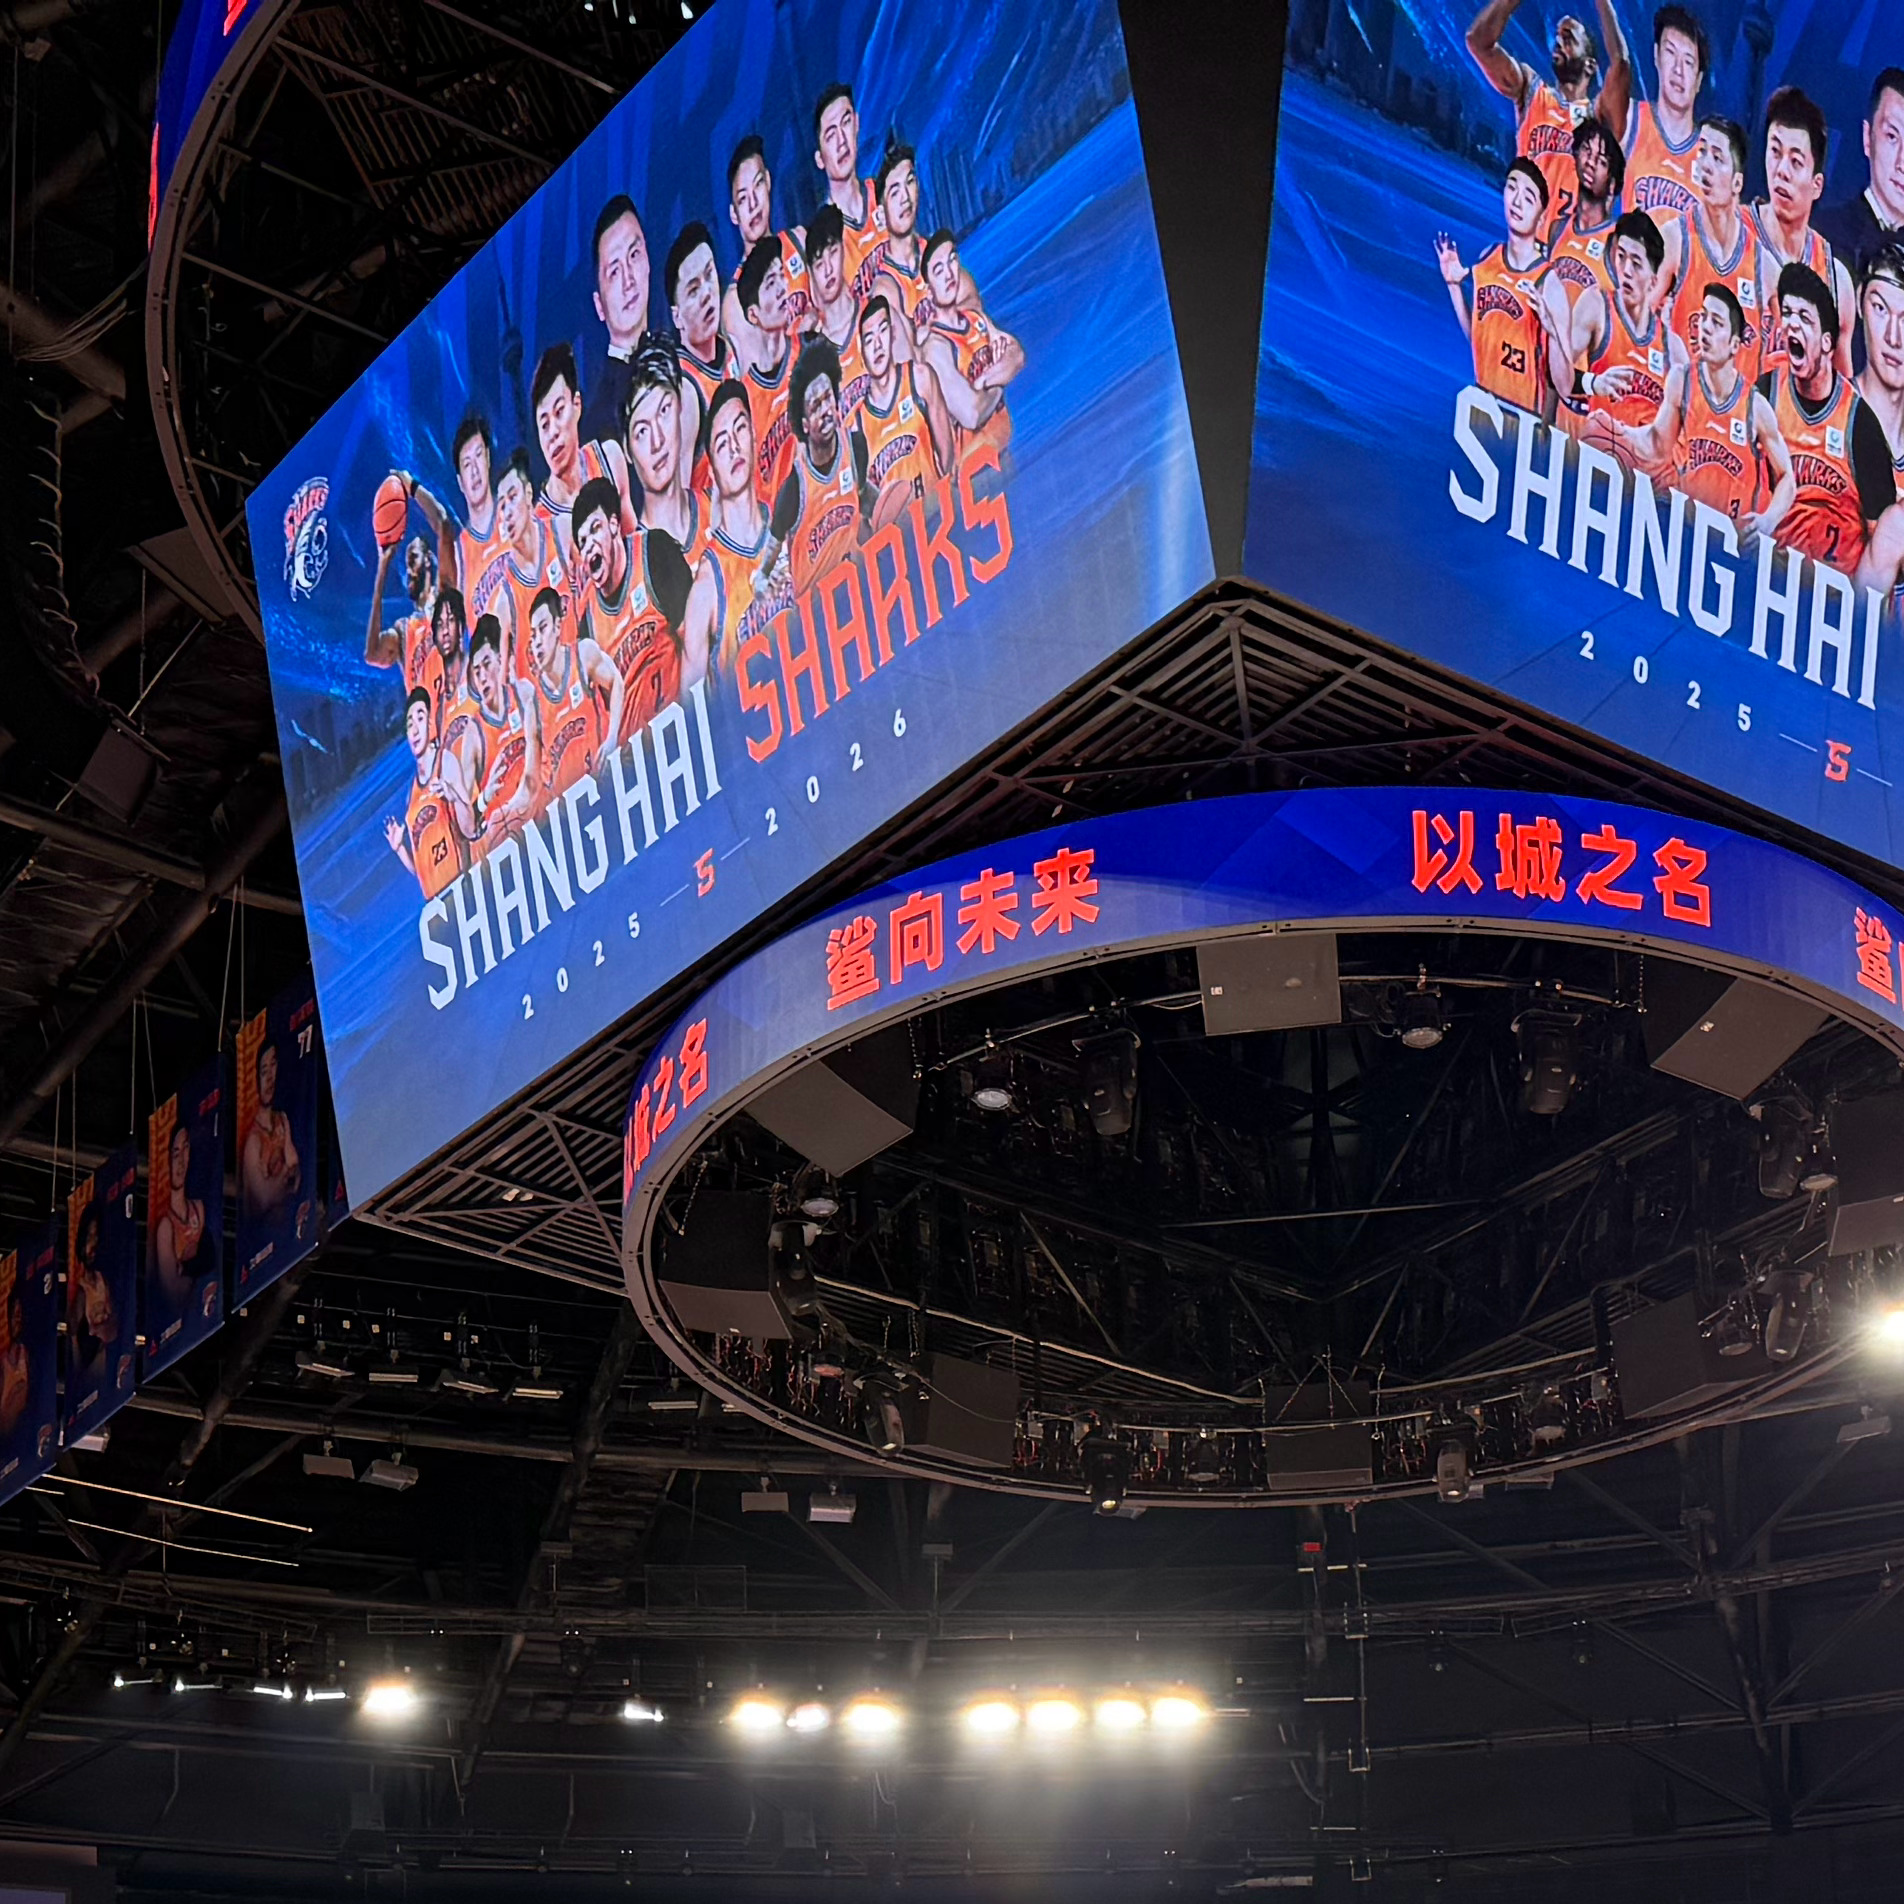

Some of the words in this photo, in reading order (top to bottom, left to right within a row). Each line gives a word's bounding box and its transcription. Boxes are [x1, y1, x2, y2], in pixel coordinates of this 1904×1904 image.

[1501, 341, 1526, 374] 23
[1448, 383, 1884, 711] SHANGHAI
[417, 680, 723, 1010] SHANGHAI
[734, 443, 1013, 764] SHARKS
[825, 847, 1100, 1011] 鲨向未来
[1411, 809, 1711, 928] 以城之名
[296, 1024, 315, 1059] 77
